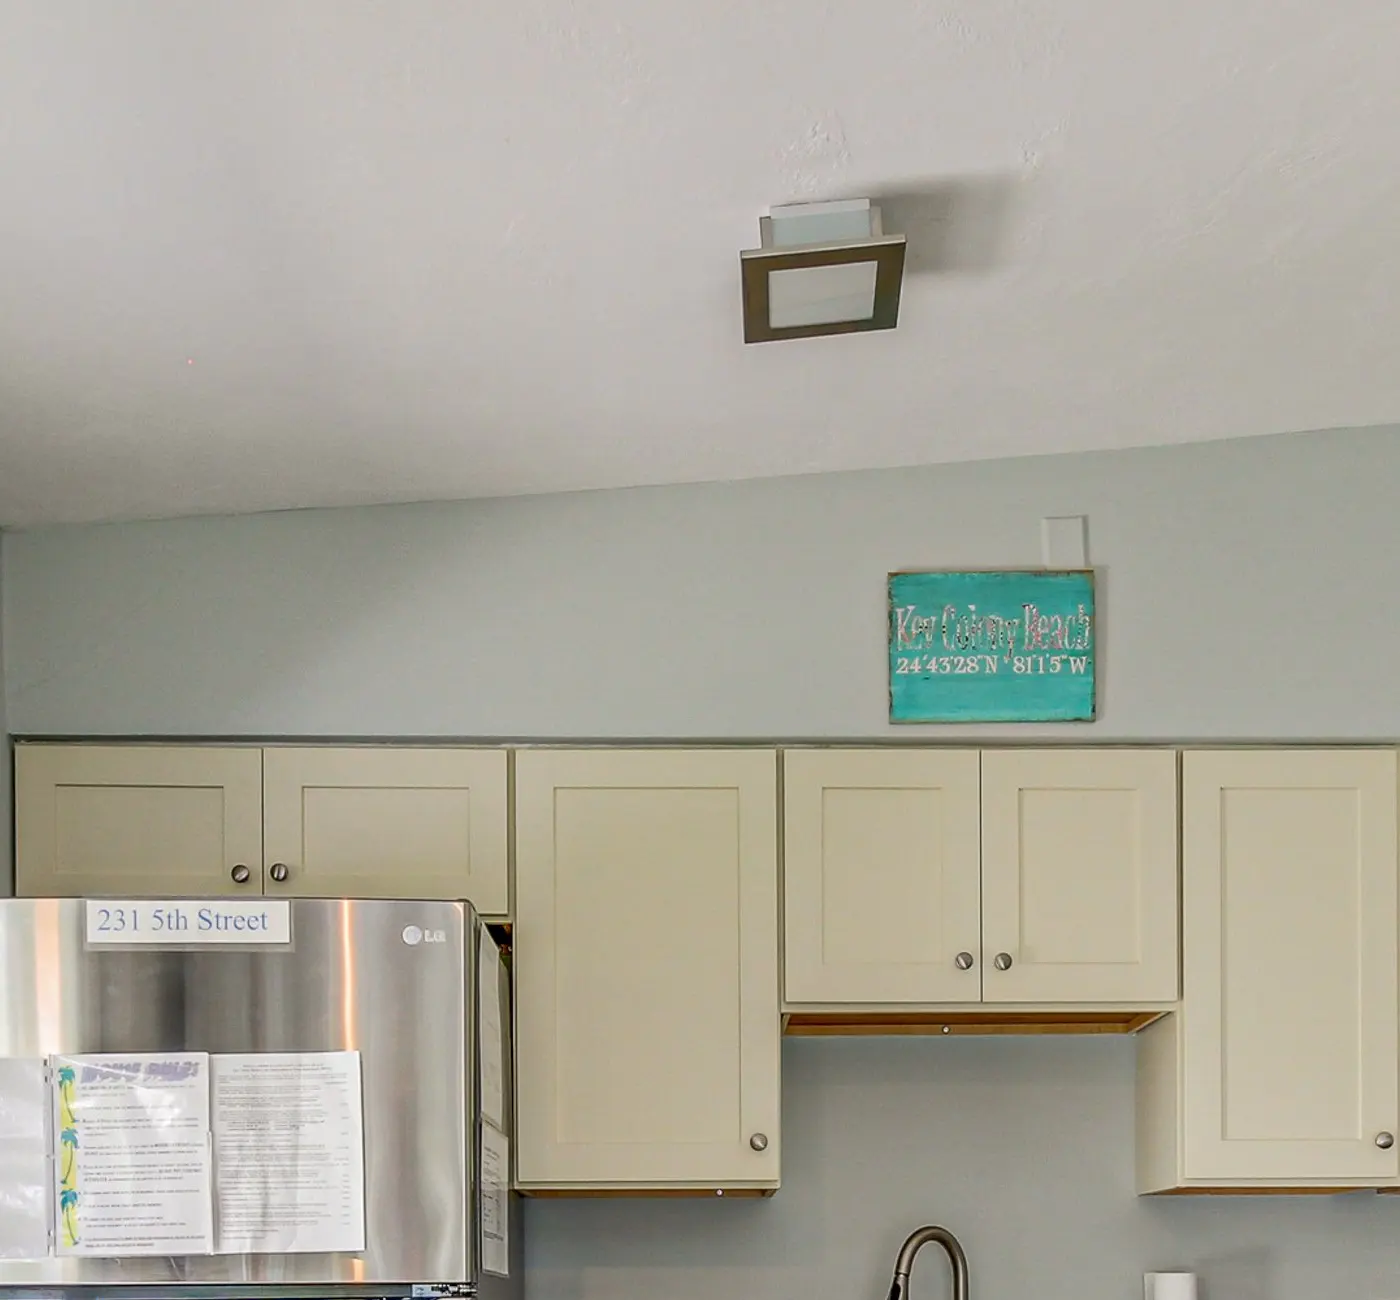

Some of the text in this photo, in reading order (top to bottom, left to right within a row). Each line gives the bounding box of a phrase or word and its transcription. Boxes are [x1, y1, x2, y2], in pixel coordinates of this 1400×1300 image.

[895, 604, 937, 651] Key
[1022, 603, 1091, 651] Beach
[97, 908, 268, 931] 231 5th Street
